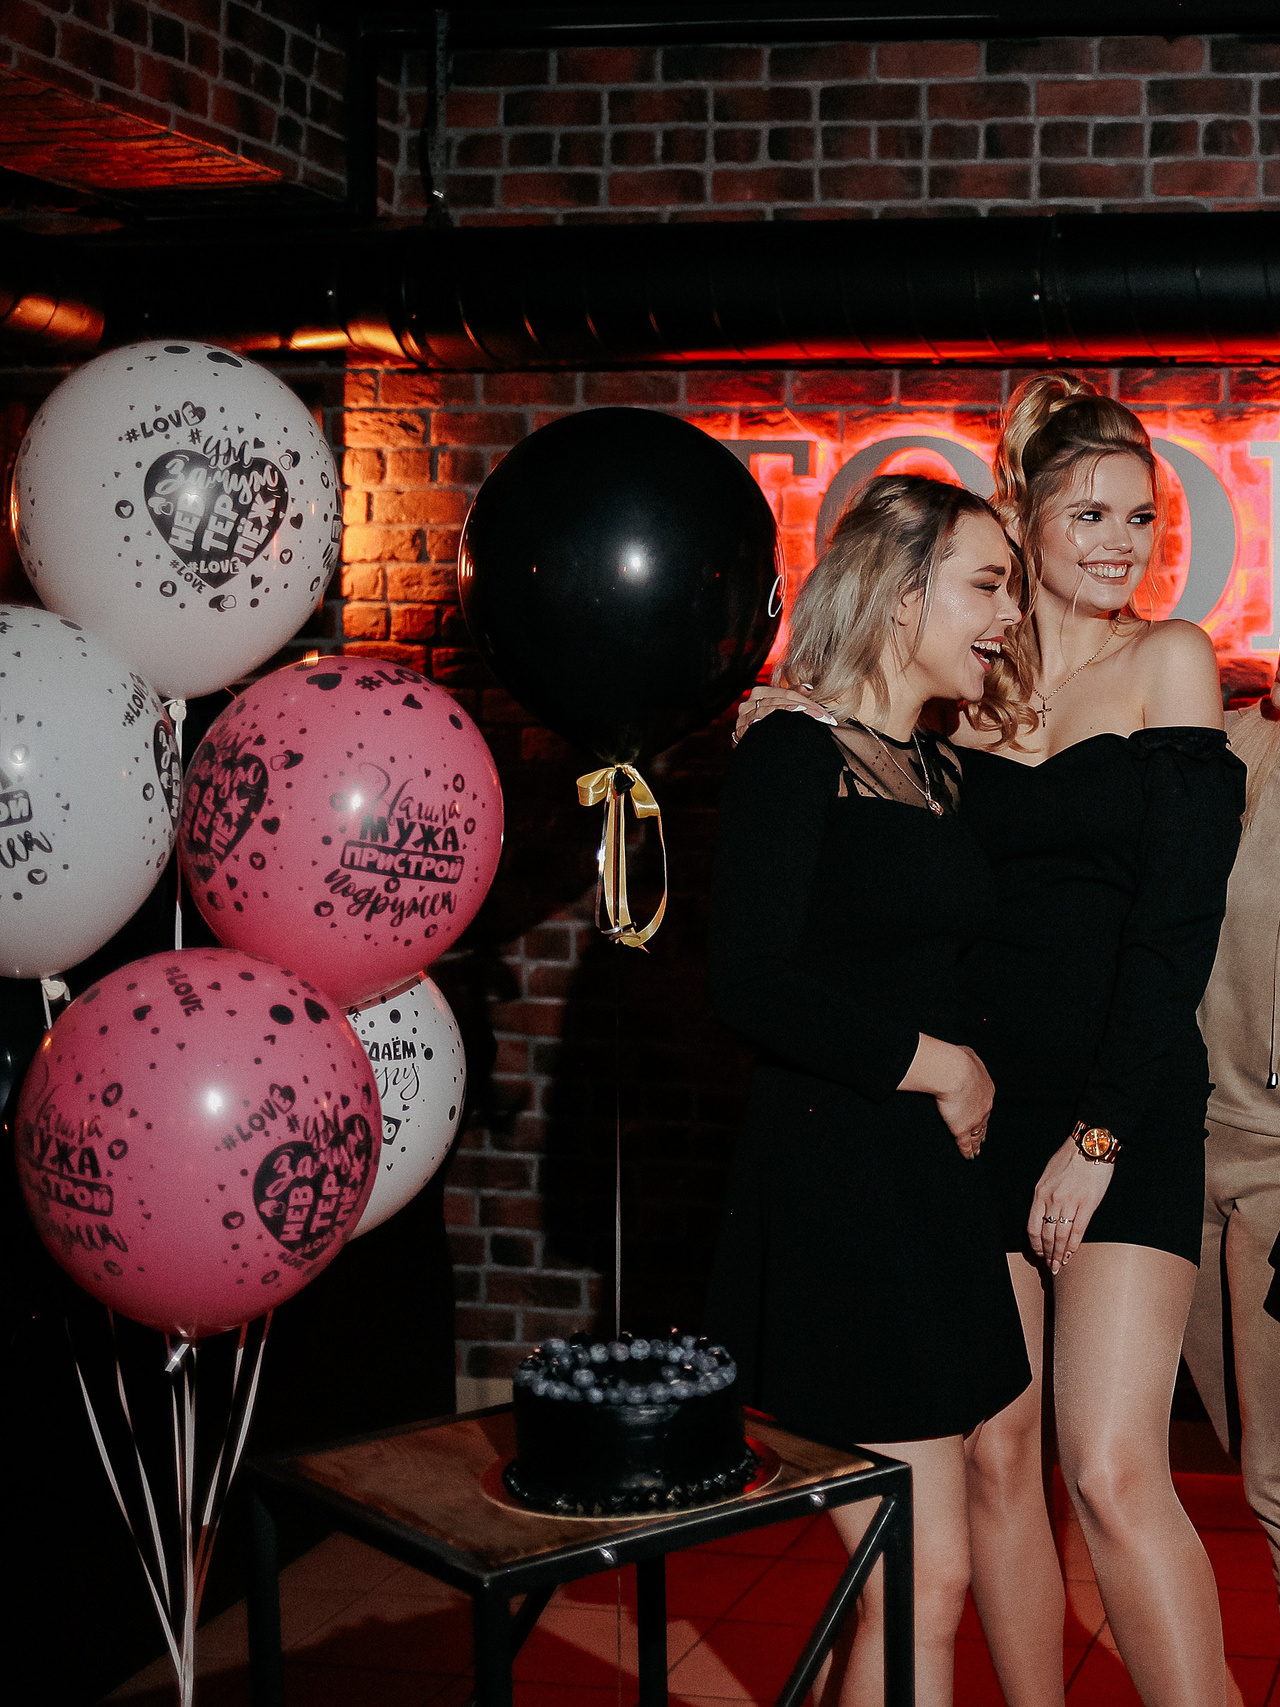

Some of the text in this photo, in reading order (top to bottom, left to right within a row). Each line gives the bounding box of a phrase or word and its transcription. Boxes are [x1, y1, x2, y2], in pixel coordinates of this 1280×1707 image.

[124, 401, 205, 443] #LOVE
[201, 494, 239, 552] ТЕР
[169, 559, 207, 595] #LOVE
[187, 557, 244, 575] #LOVE
[360, 814, 460, 852] МУЖА
[343, 846, 463, 881] ПРИСТРОЙ
[362, 1036, 417, 1062] ДАЁМ
[280, 1184, 315, 1242] НЕВ
[310, 1173, 341, 1234] ТЕР
